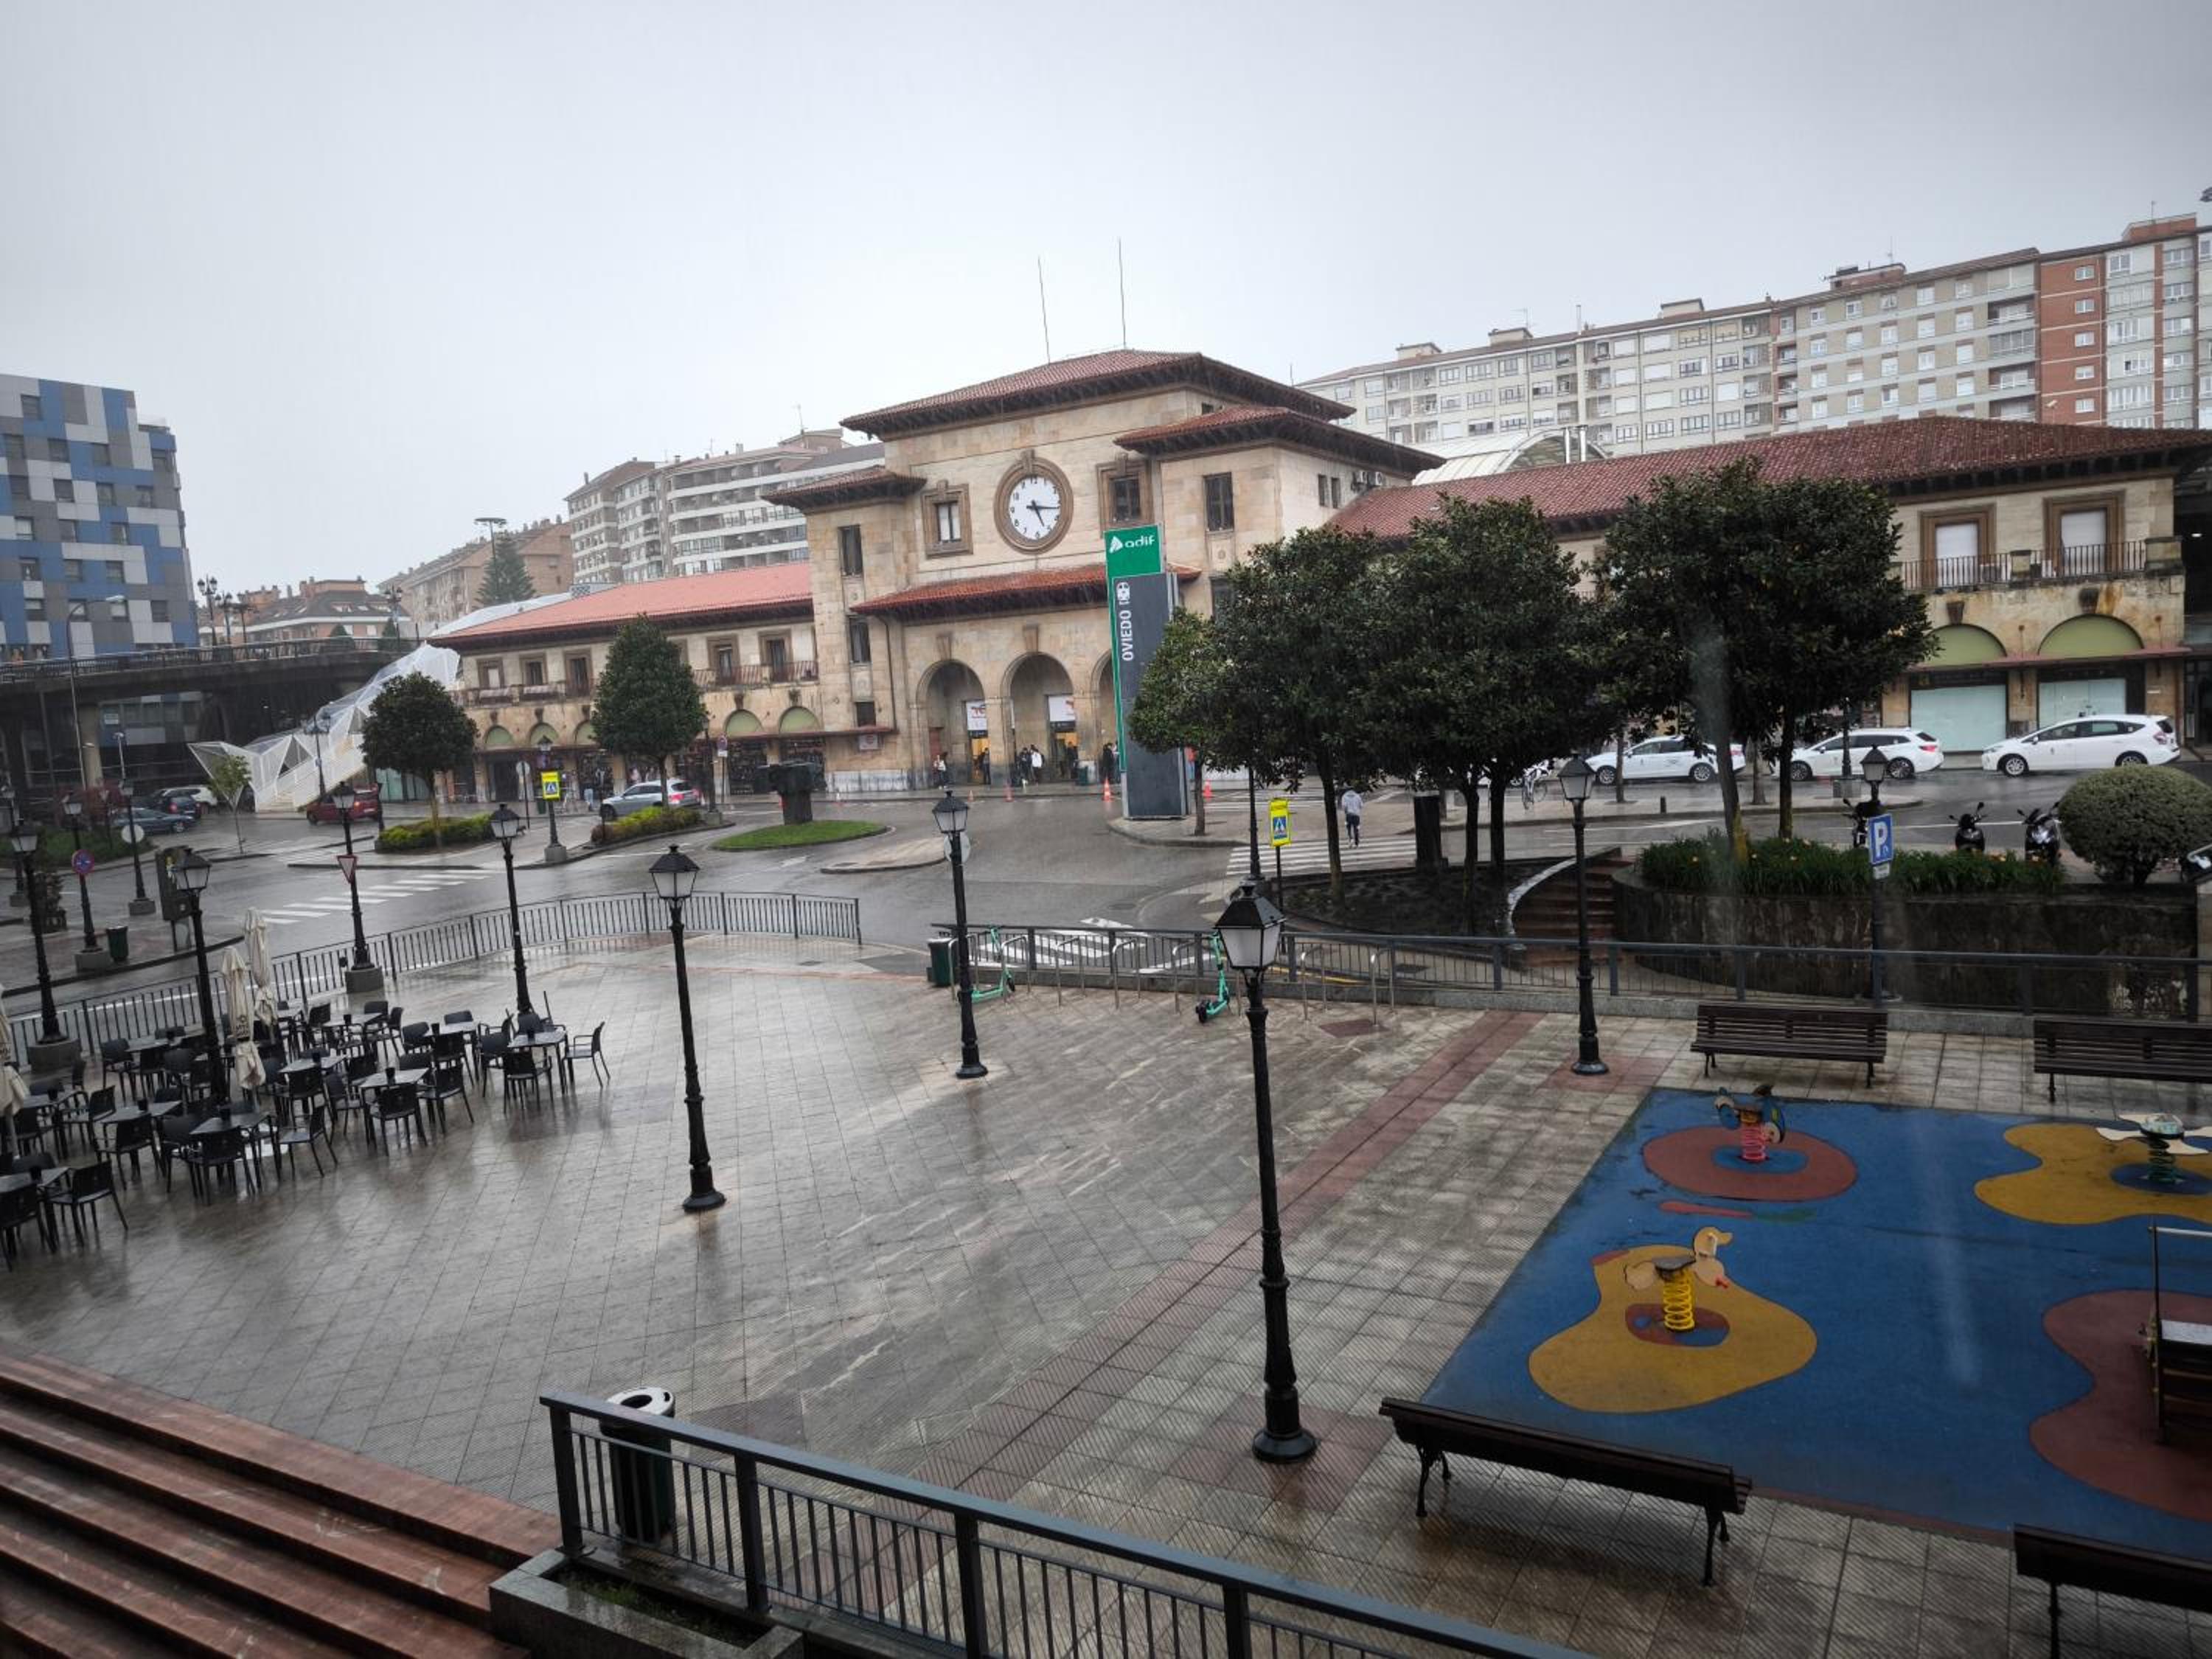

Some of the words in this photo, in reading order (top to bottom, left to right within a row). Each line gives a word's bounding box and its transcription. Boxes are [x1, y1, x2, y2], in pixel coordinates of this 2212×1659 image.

[1124, 535, 1155, 548] adif
[1119, 610, 1134, 661] OVIEDO
[1874, 821, 1888, 858] P
